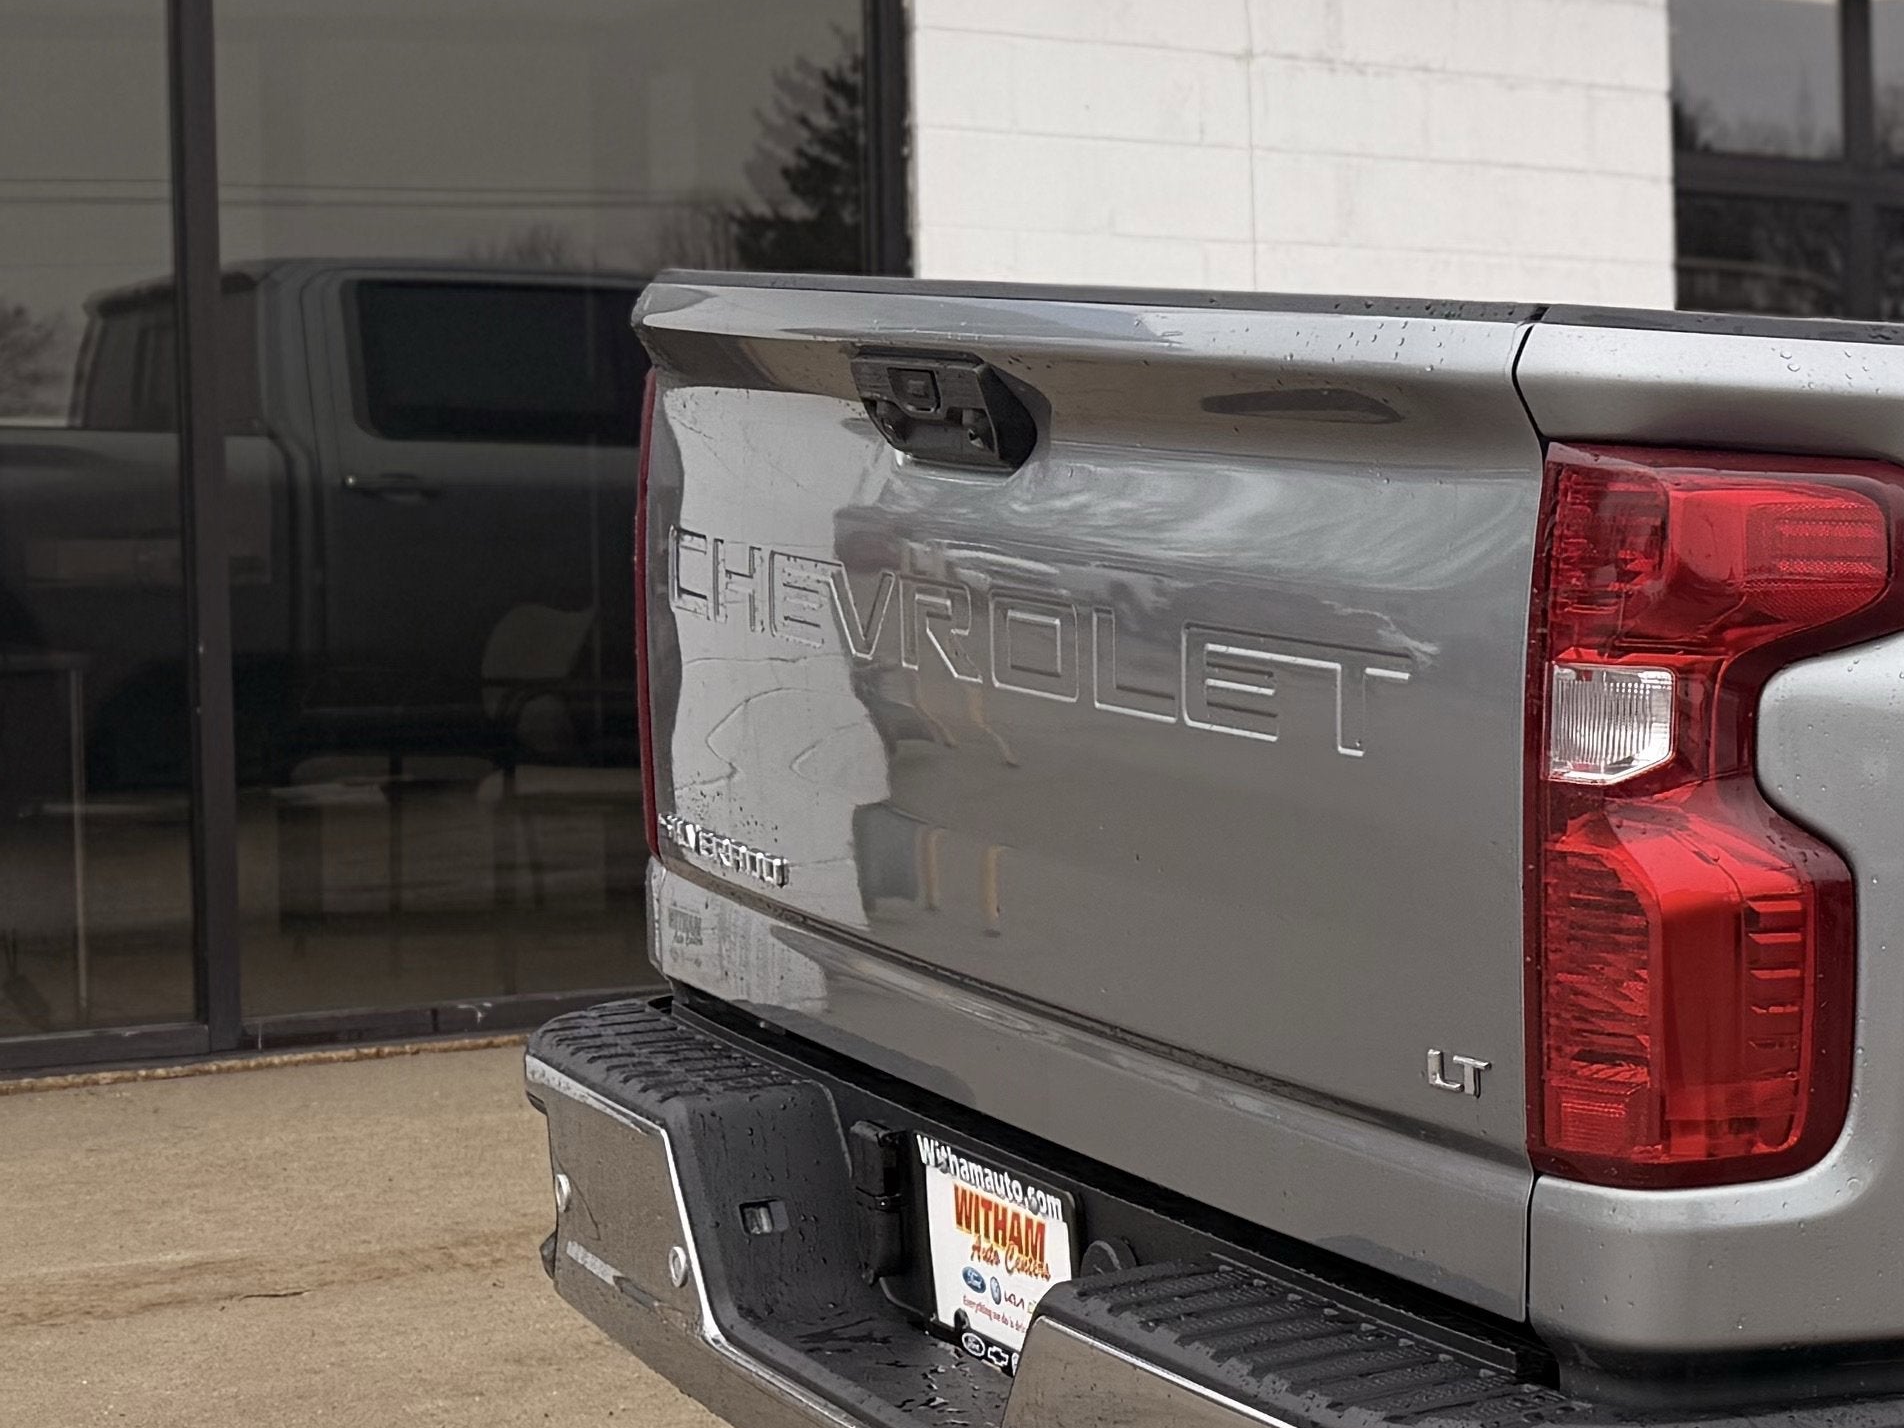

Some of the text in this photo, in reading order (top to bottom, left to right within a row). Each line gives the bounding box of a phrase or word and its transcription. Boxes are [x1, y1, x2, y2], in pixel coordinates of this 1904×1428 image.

[668, 524, 1413, 759] CHEVROLET
[1426, 1048, 1491, 1099] LT
[953, 1184, 1046, 1263] WITHAM
